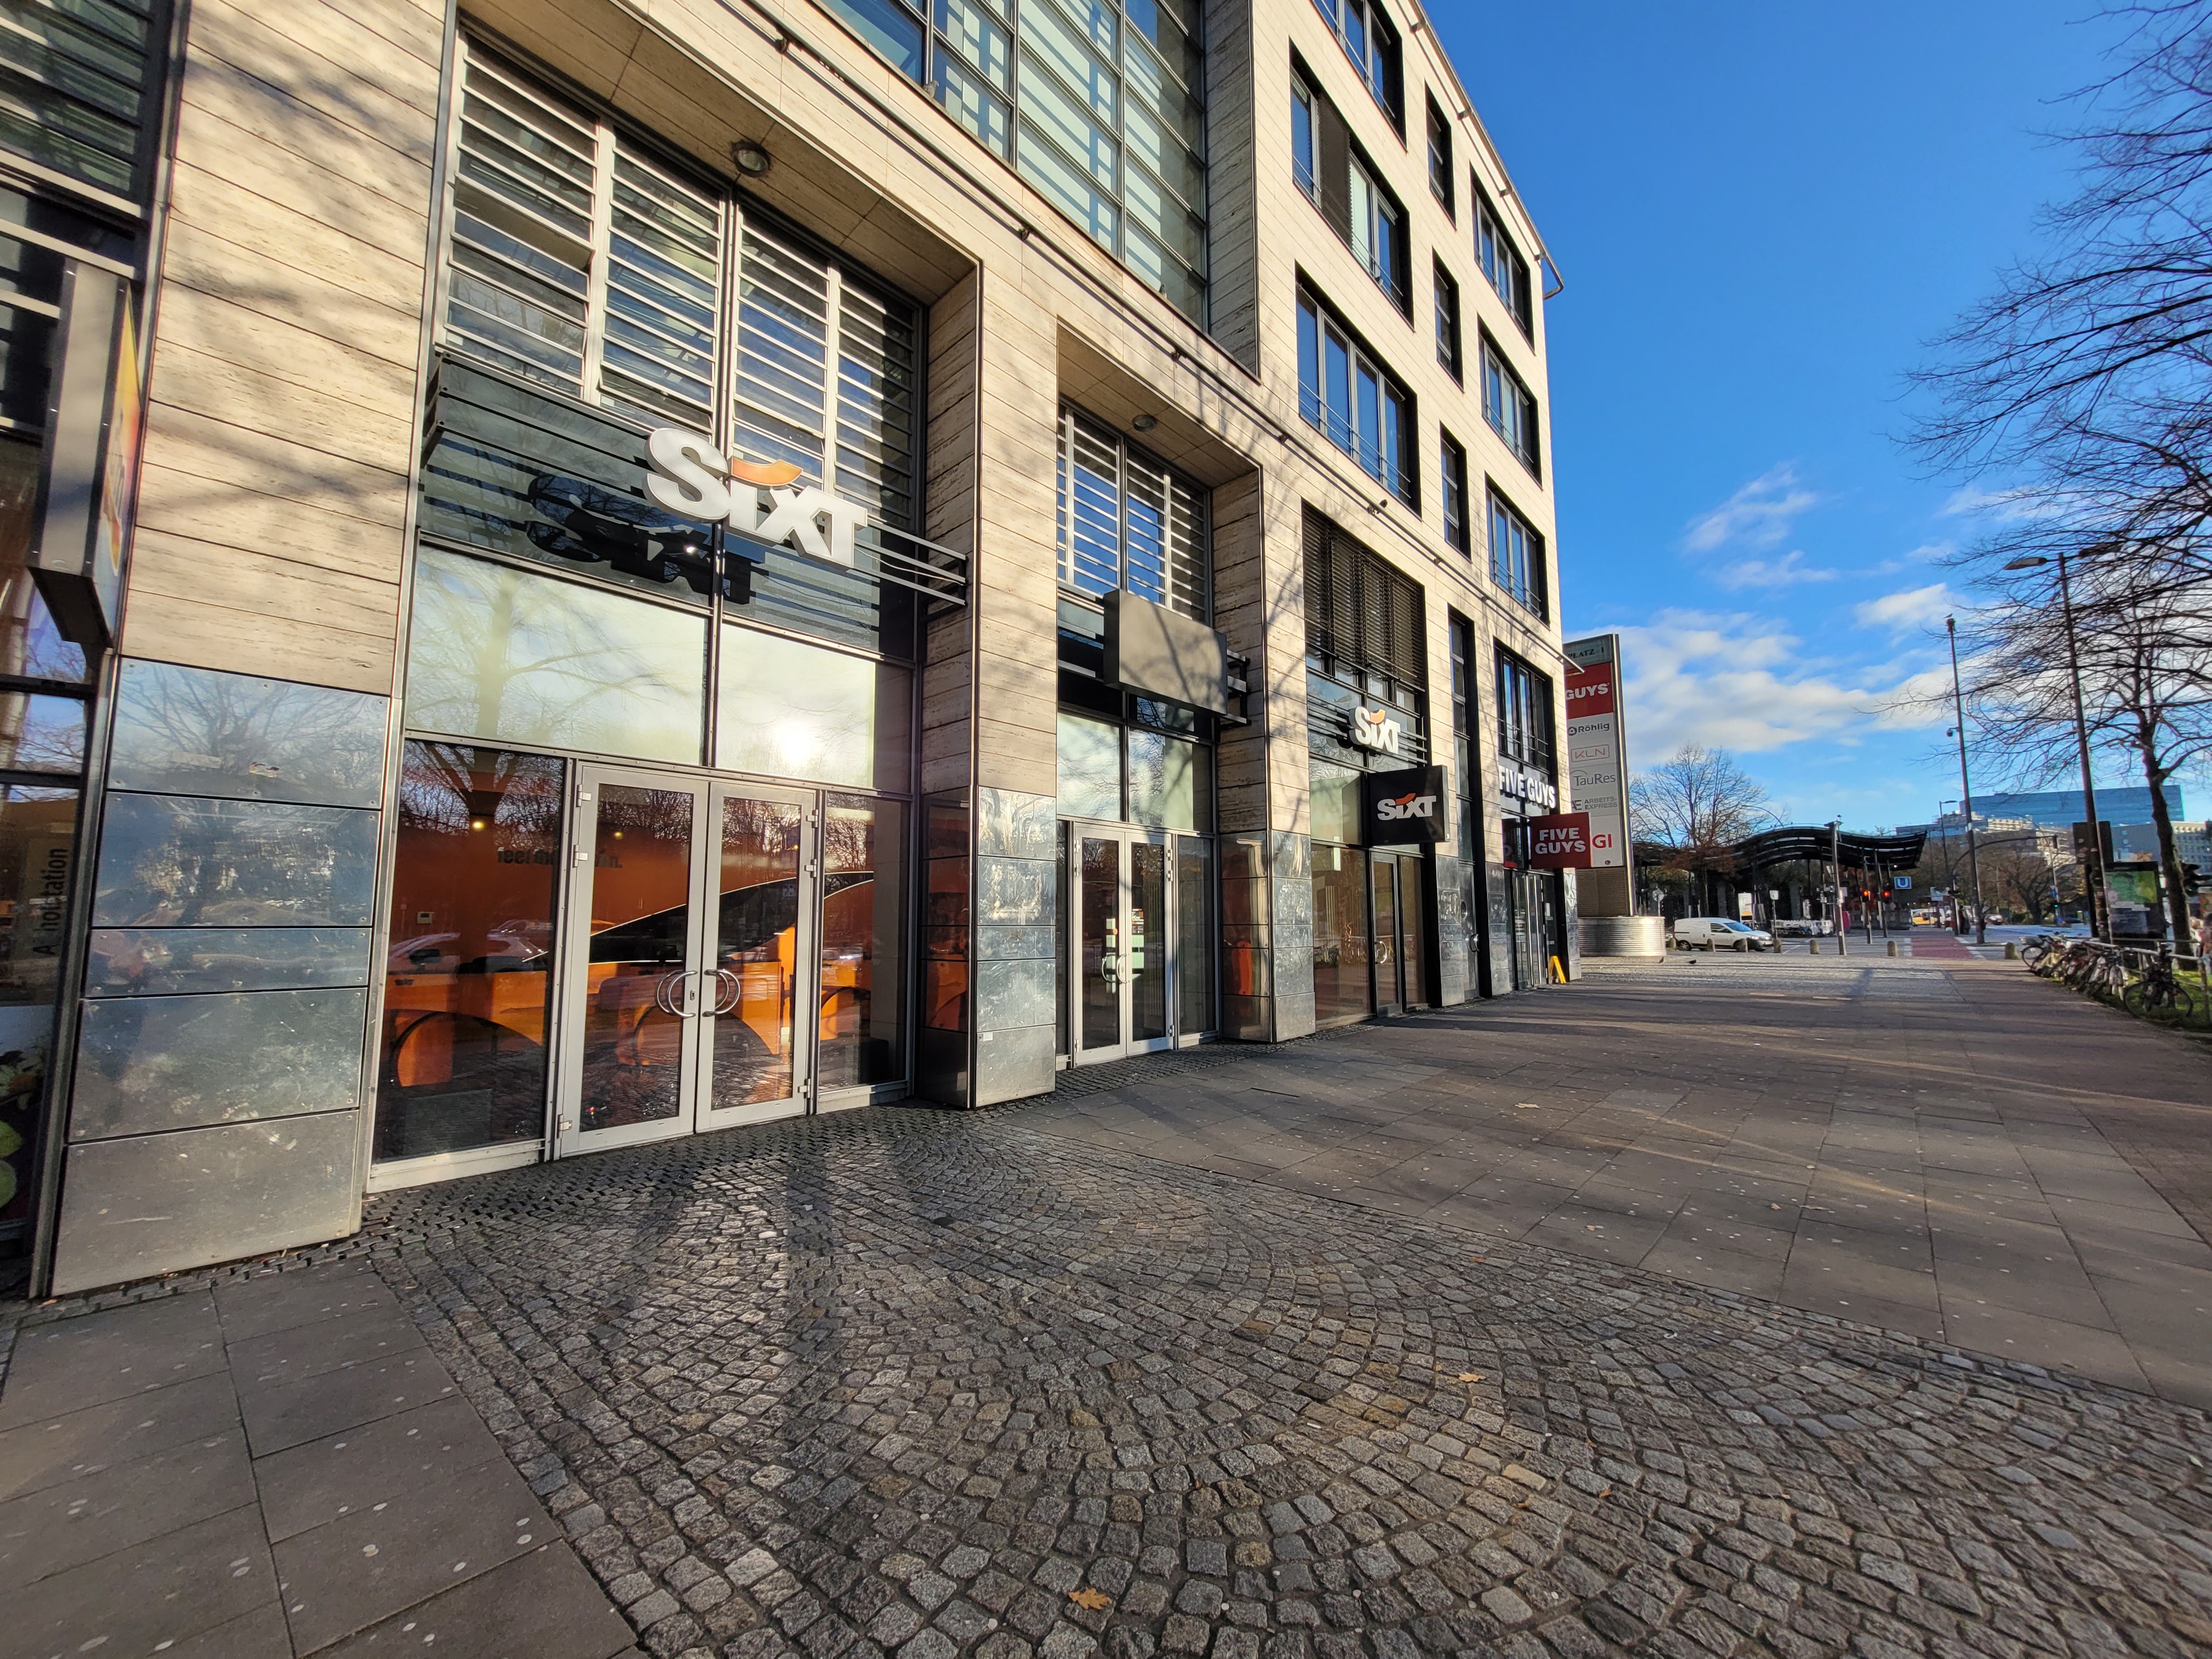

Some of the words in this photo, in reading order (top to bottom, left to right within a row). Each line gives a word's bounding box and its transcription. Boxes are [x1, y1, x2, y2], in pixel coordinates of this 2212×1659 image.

[1566, 683, 1609, 700] GUYS
[1578, 723, 1610, 733] Röhlig
[1575, 748, 1605, 759] KLN
[1498, 765, 1526, 798] FIVE
[1527, 777, 1556, 808] GUYS
[1573, 774, 1616, 786] TauRes
[1540, 827, 1580, 841] FIVE
[1535, 840, 1586, 854] GUYS
[1897, 878, 1908, 888] U
